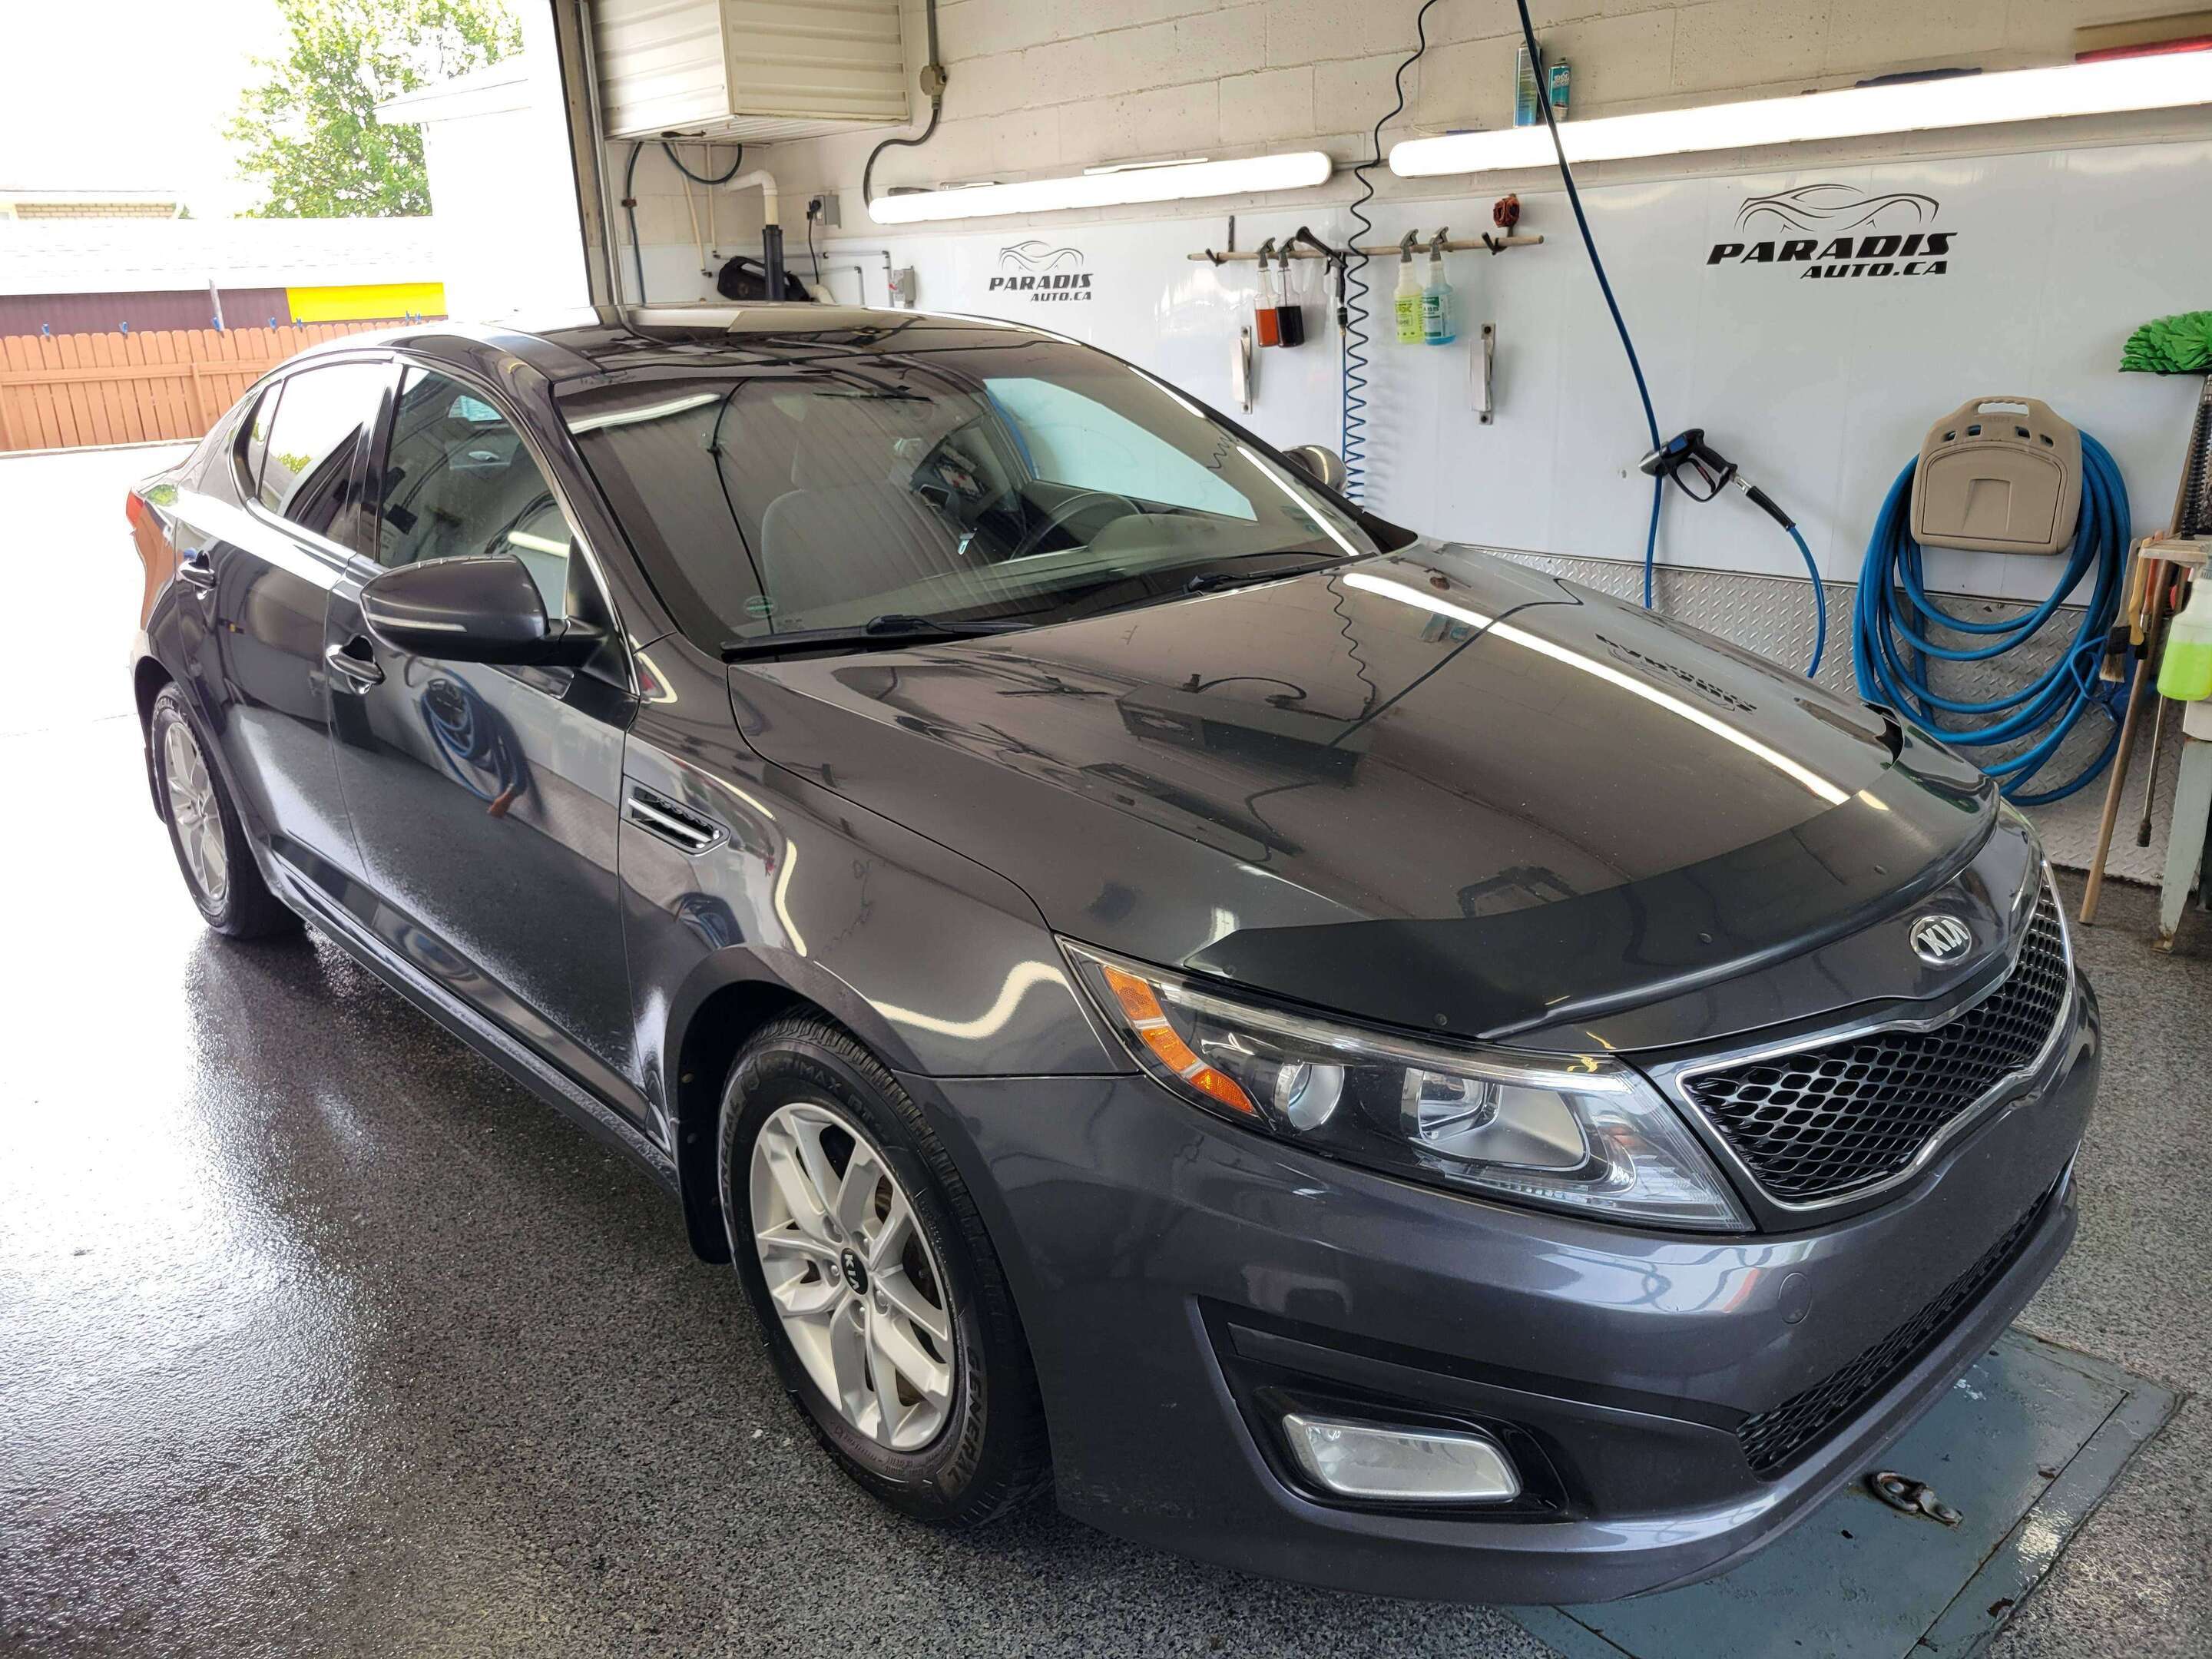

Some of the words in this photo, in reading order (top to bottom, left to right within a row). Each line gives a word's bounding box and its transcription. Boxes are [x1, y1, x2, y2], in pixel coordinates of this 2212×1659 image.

[1707, 232, 1958, 265] PARADIS
[988, 273, 1094, 291] PARADIS
[1800, 260, 1948, 280] AUTO.CA
[1030, 291, 1091, 302] AUTO.CA
[1916, 919, 1969, 957] KIA
[844, 1253, 860, 1290] KIA
[947, 1346, 982, 1482] GENERAL
